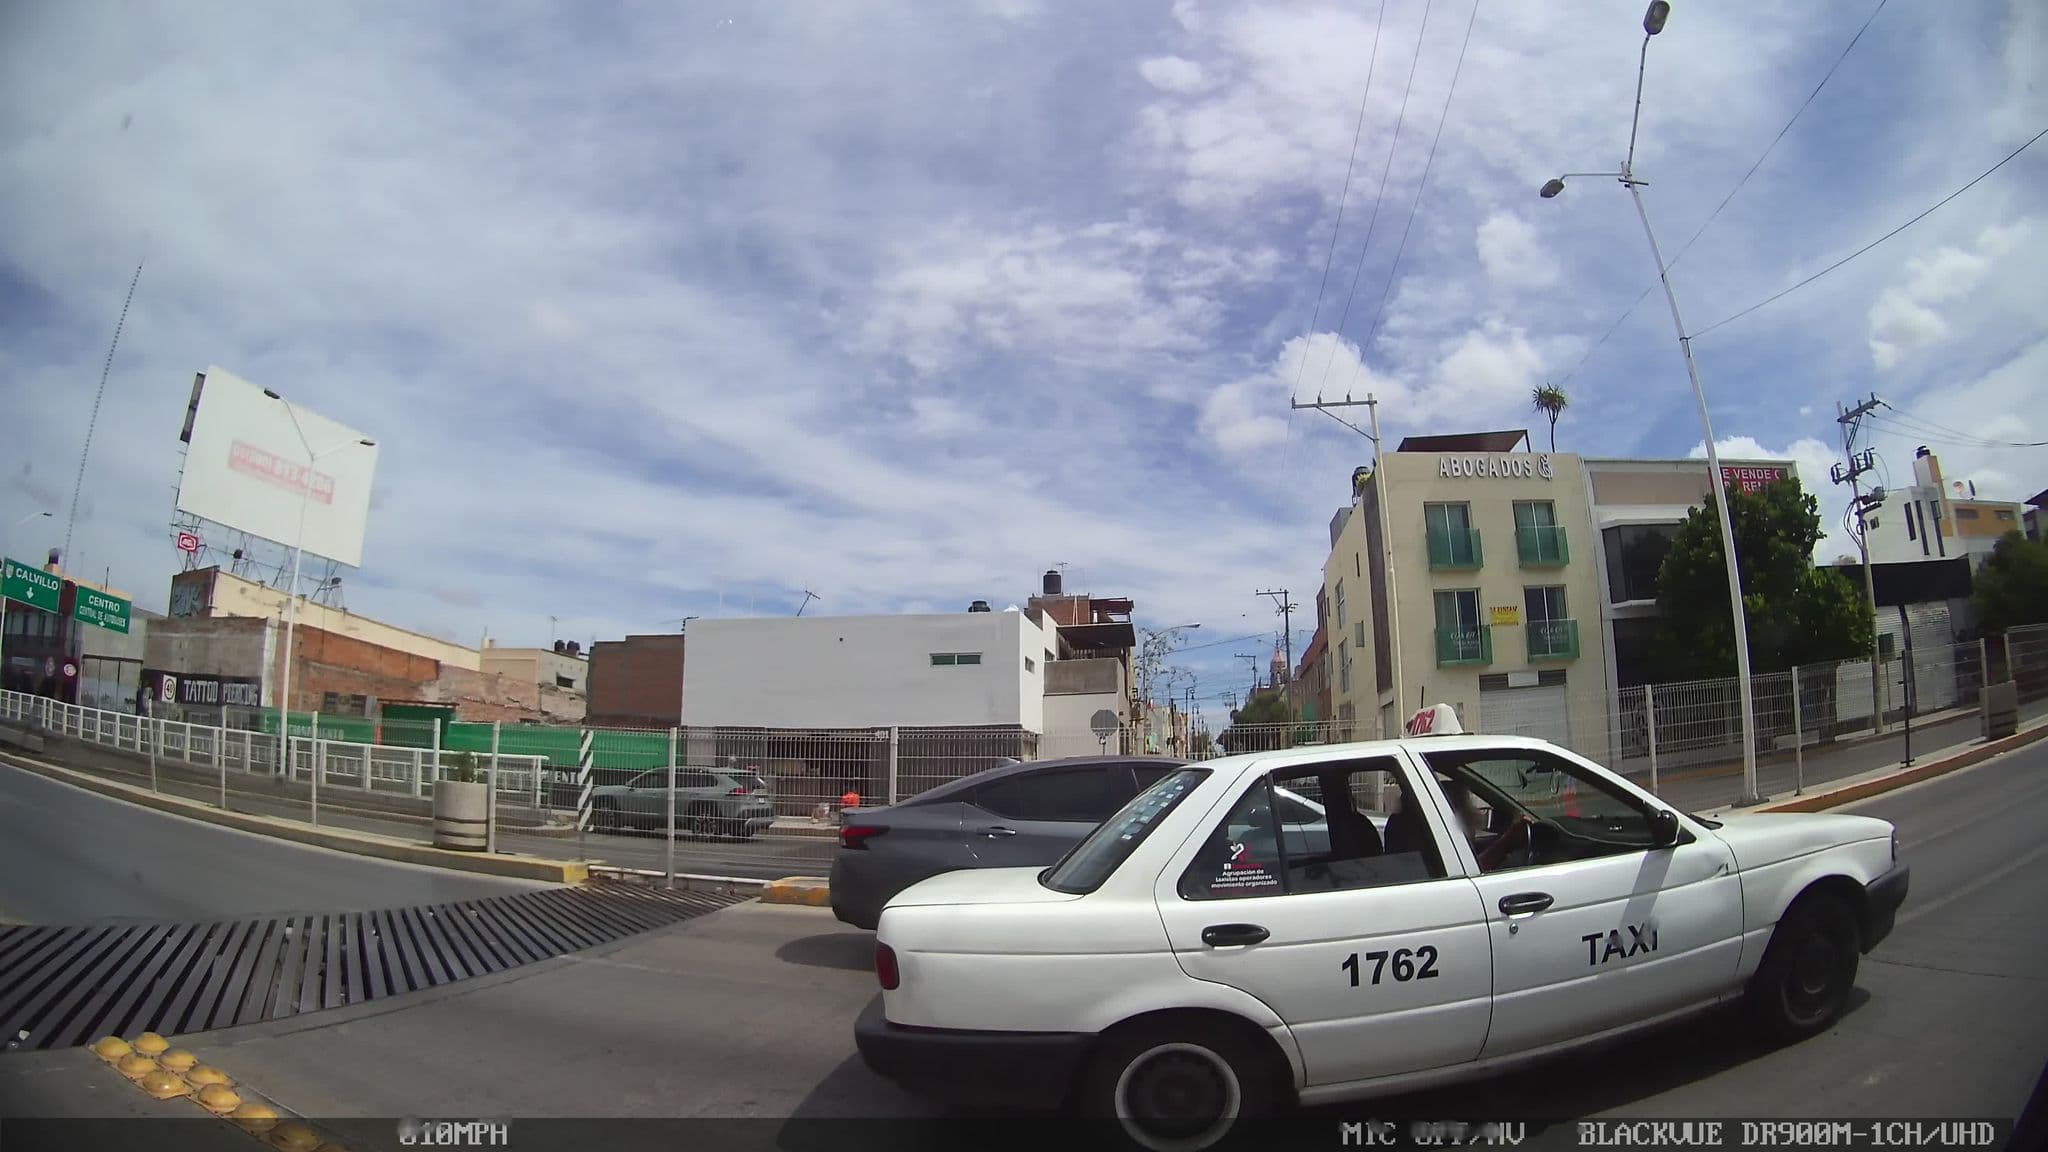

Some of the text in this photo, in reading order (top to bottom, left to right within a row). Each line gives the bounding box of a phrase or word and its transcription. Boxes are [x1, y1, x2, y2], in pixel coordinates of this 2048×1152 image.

[1440, 456, 1532, 478] ABOGADOS
[1733, 468, 1771, 479] VENDE
[15, 567, 59, 591] CALVILLO
[88, 595, 120, 612] CENTRO
[183, 680, 219, 703] TATTOO
[1582, 922, 1658, 966] TAXI
[1342, 945, 1439, 987] 1762
